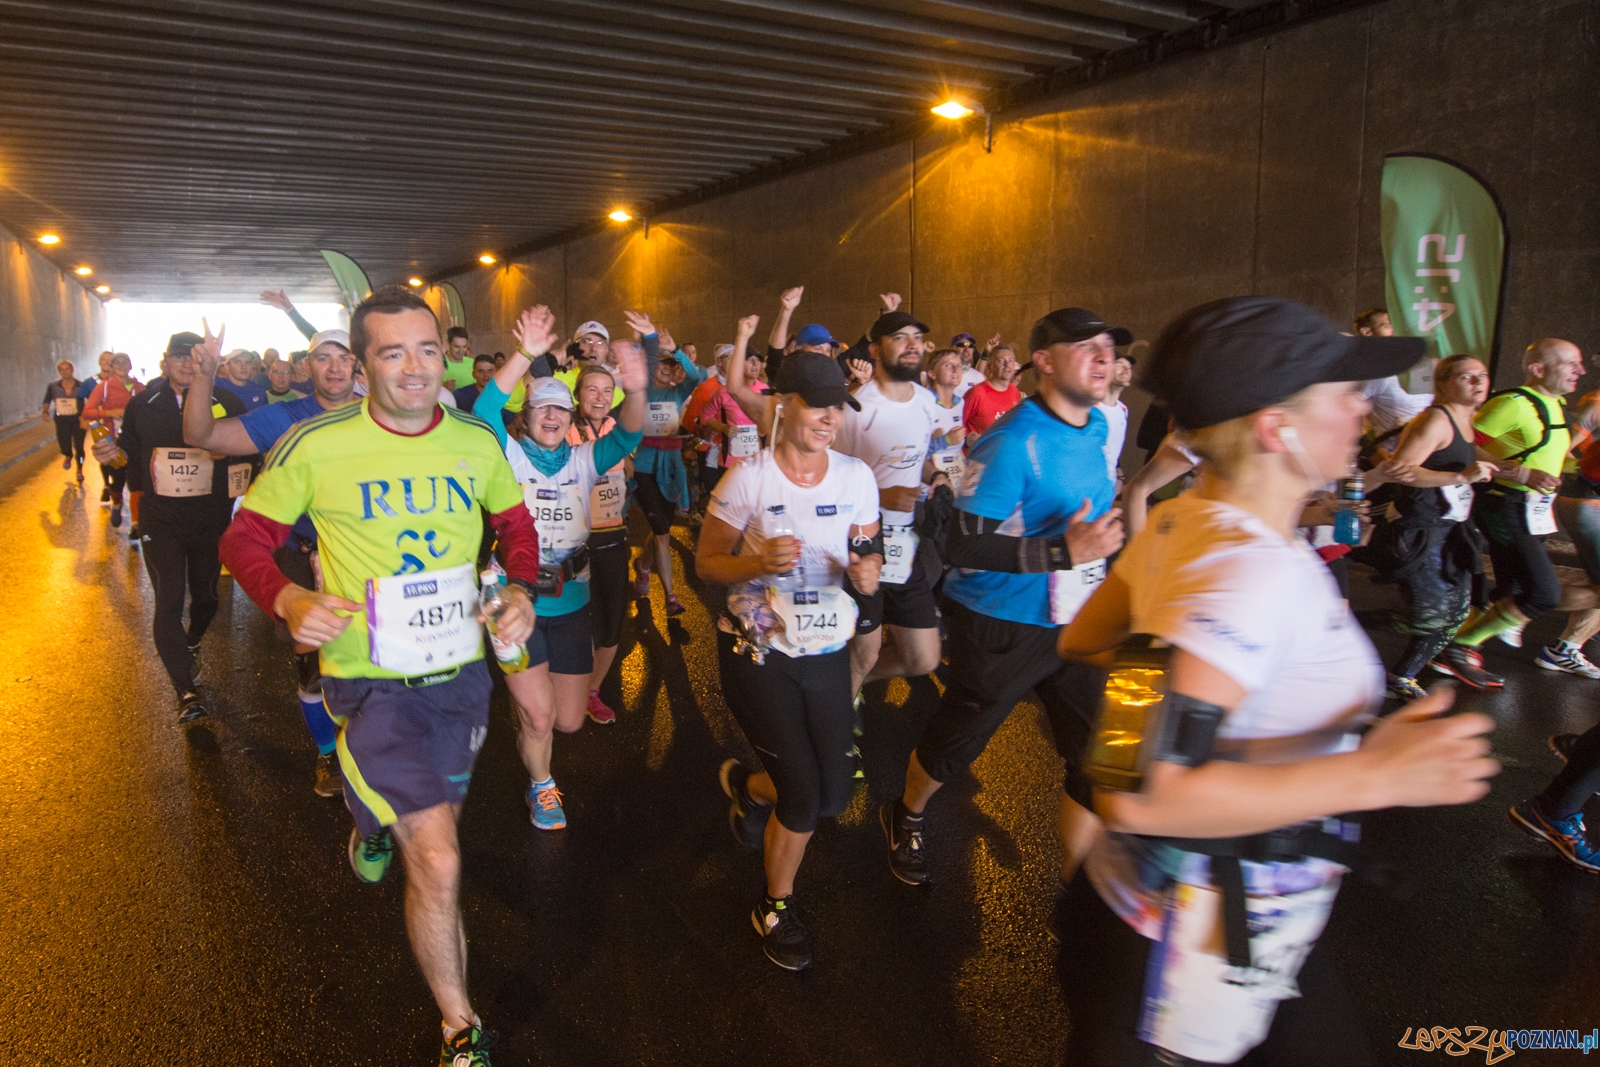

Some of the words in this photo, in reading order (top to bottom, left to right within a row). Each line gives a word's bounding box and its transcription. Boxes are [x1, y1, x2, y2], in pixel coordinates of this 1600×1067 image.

[652, 413, 671, 422] 932
[170, 465, 199, 475] 1412
[356, 475, 477, 521] RUN
[598, 486, 620, 502] 504
[534, 507, 573, 522] 1866
[408, 600, 464, 628] 4871
[794, 612, 838, 631] 1744
